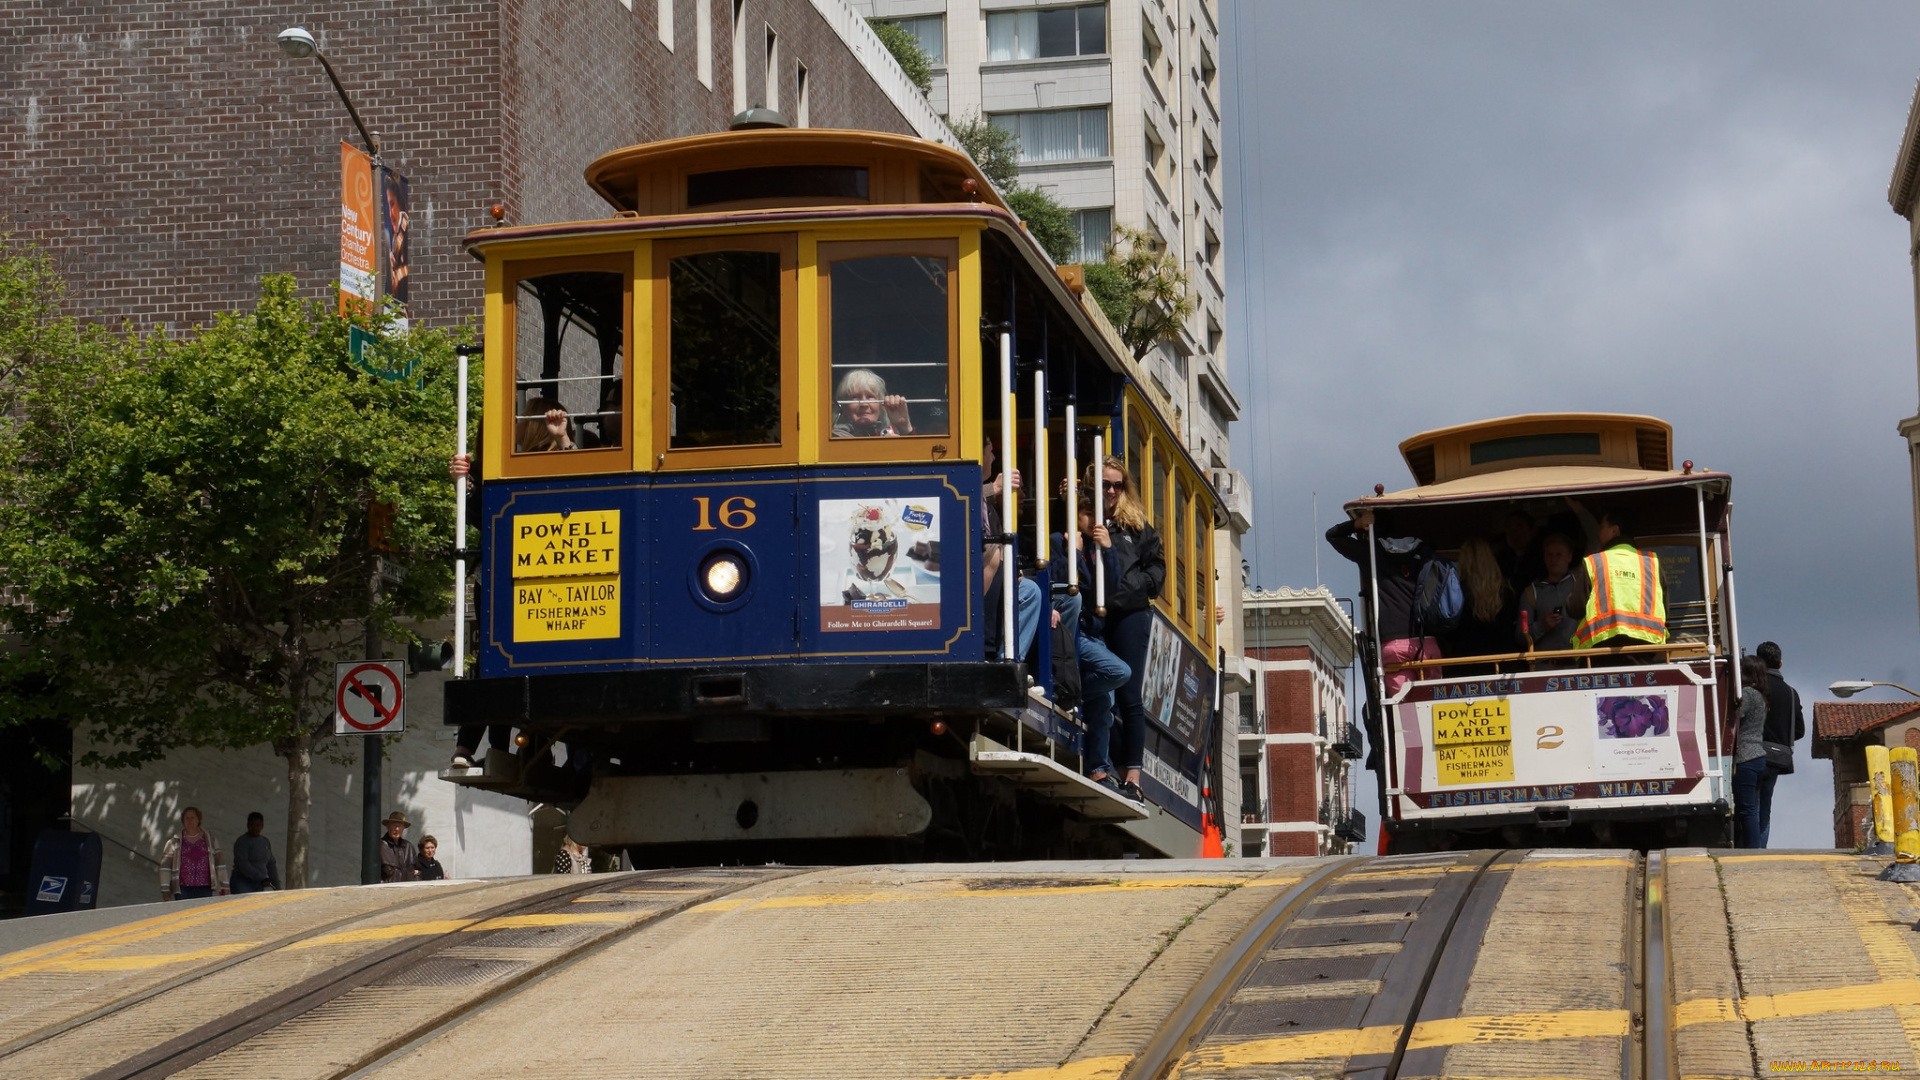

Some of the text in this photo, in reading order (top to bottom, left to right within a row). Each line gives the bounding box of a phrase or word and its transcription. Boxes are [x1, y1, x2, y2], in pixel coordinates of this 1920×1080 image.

[342, 204, 358, 223] New
[341, 219, 372, 246] Century
[341, 234, 368, 256] Chamber
[341, 248, 370, 269] Orchestra
[692, 496, 757, 531] 16
[520, 521, 613, 539] POWELL
[545, 538, 590, 550] AND
[517, 548, 614, 567] MARKET
[1614, 570, 1636, 579] SFMTA
[519, 584, 615, 605] BAY AND TAYLOR
[527, 605, 606, 620] FISHERMANS
[853, 601, 906, 609] GHIRARDELLI
[546, 619, 587, 631] WHARF
[872, 620, 907, 628] Ghirardelli
[908, 619, 933, 628] Square!
[1433, 680, 1525, 699] MARKET
[1545, 673, 1636, 692] STREET
[1438, 707, 1505, 720] POWELL
[1457, 718, 1490, 727] AND
[1438, 726, 1507, 739] MARKET
[1536, 725, 1564, 750] 2
[1439, 749, 1456, 761] BAY
[1473, 745, 1509, 758] TAYLOR
[1446, 760, 1503, 771] FISHERMANS
[1460, 769, 1489, 778] WHARF
[1430, 780, 1676, 807] FISHERMANS WHARF
